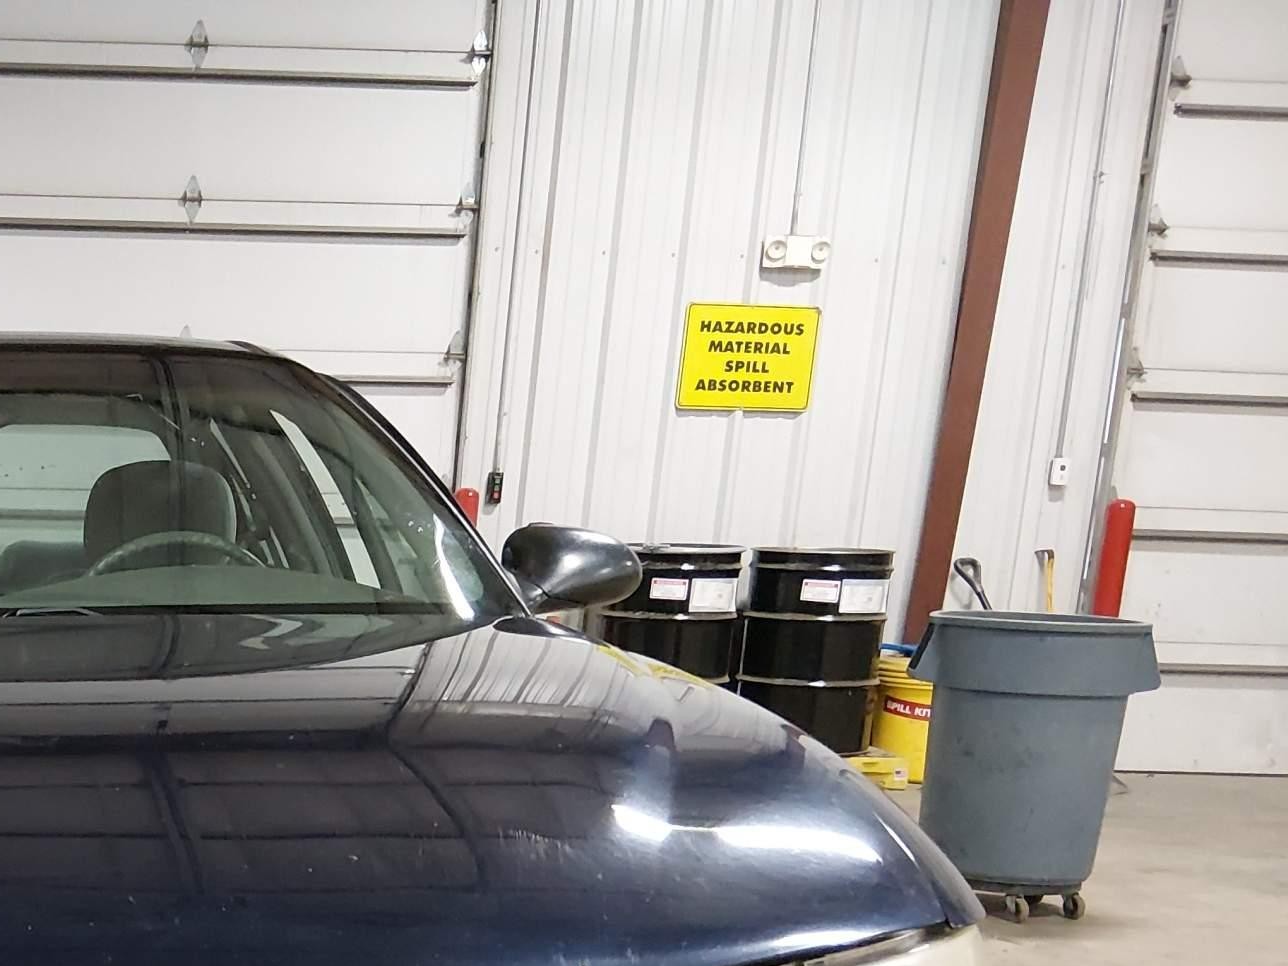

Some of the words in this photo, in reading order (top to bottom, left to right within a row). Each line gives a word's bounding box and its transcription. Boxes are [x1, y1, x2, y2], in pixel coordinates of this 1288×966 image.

[700, 320, 805, 336] HAZARDOUS
[708, 340, 791, 355] MATERIAL
[724, 360, 770, 374] SPILL
[695, 379, 795, 394] ABSORBENT
